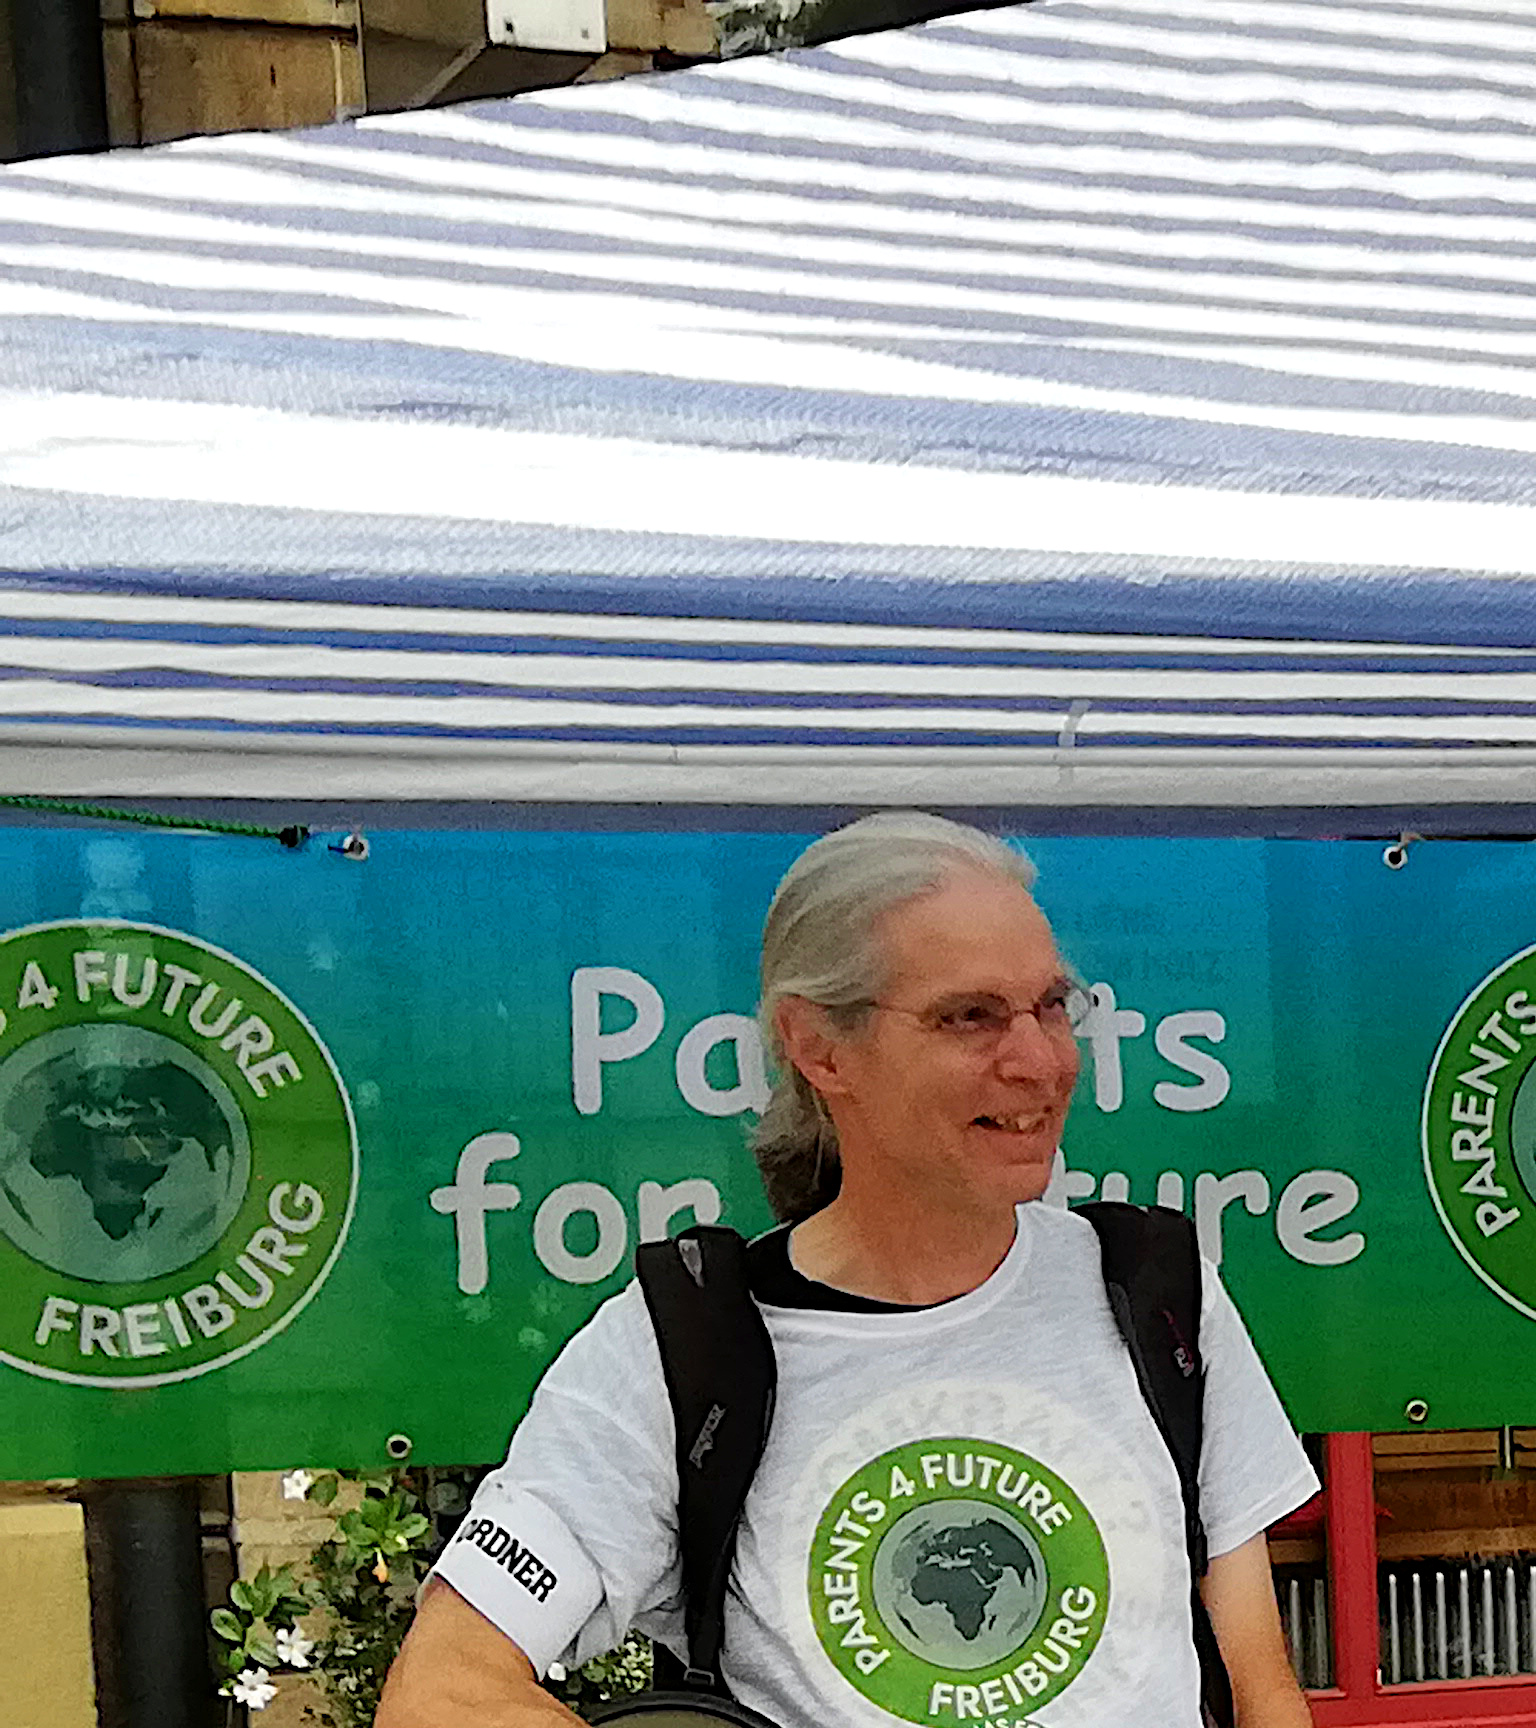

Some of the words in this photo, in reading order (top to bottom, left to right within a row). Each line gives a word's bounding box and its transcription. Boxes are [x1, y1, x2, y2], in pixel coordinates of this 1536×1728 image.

[18, 960, 60, 1011] 4
[73, 951, 303, 1098] FUTURE
[570, 965, 1232, 1117] Pats
[34, 1180, 325, 1358] FREIBURG
[430, 1131, 722, 1296] for
[823, 1490, 892, 1677] PARENTS
[889, 1465, 917, 1500] 4
[920, 1452, 1073, 1537] FUTURE
[928, 1584, 1097, 1719] FREIBURG
